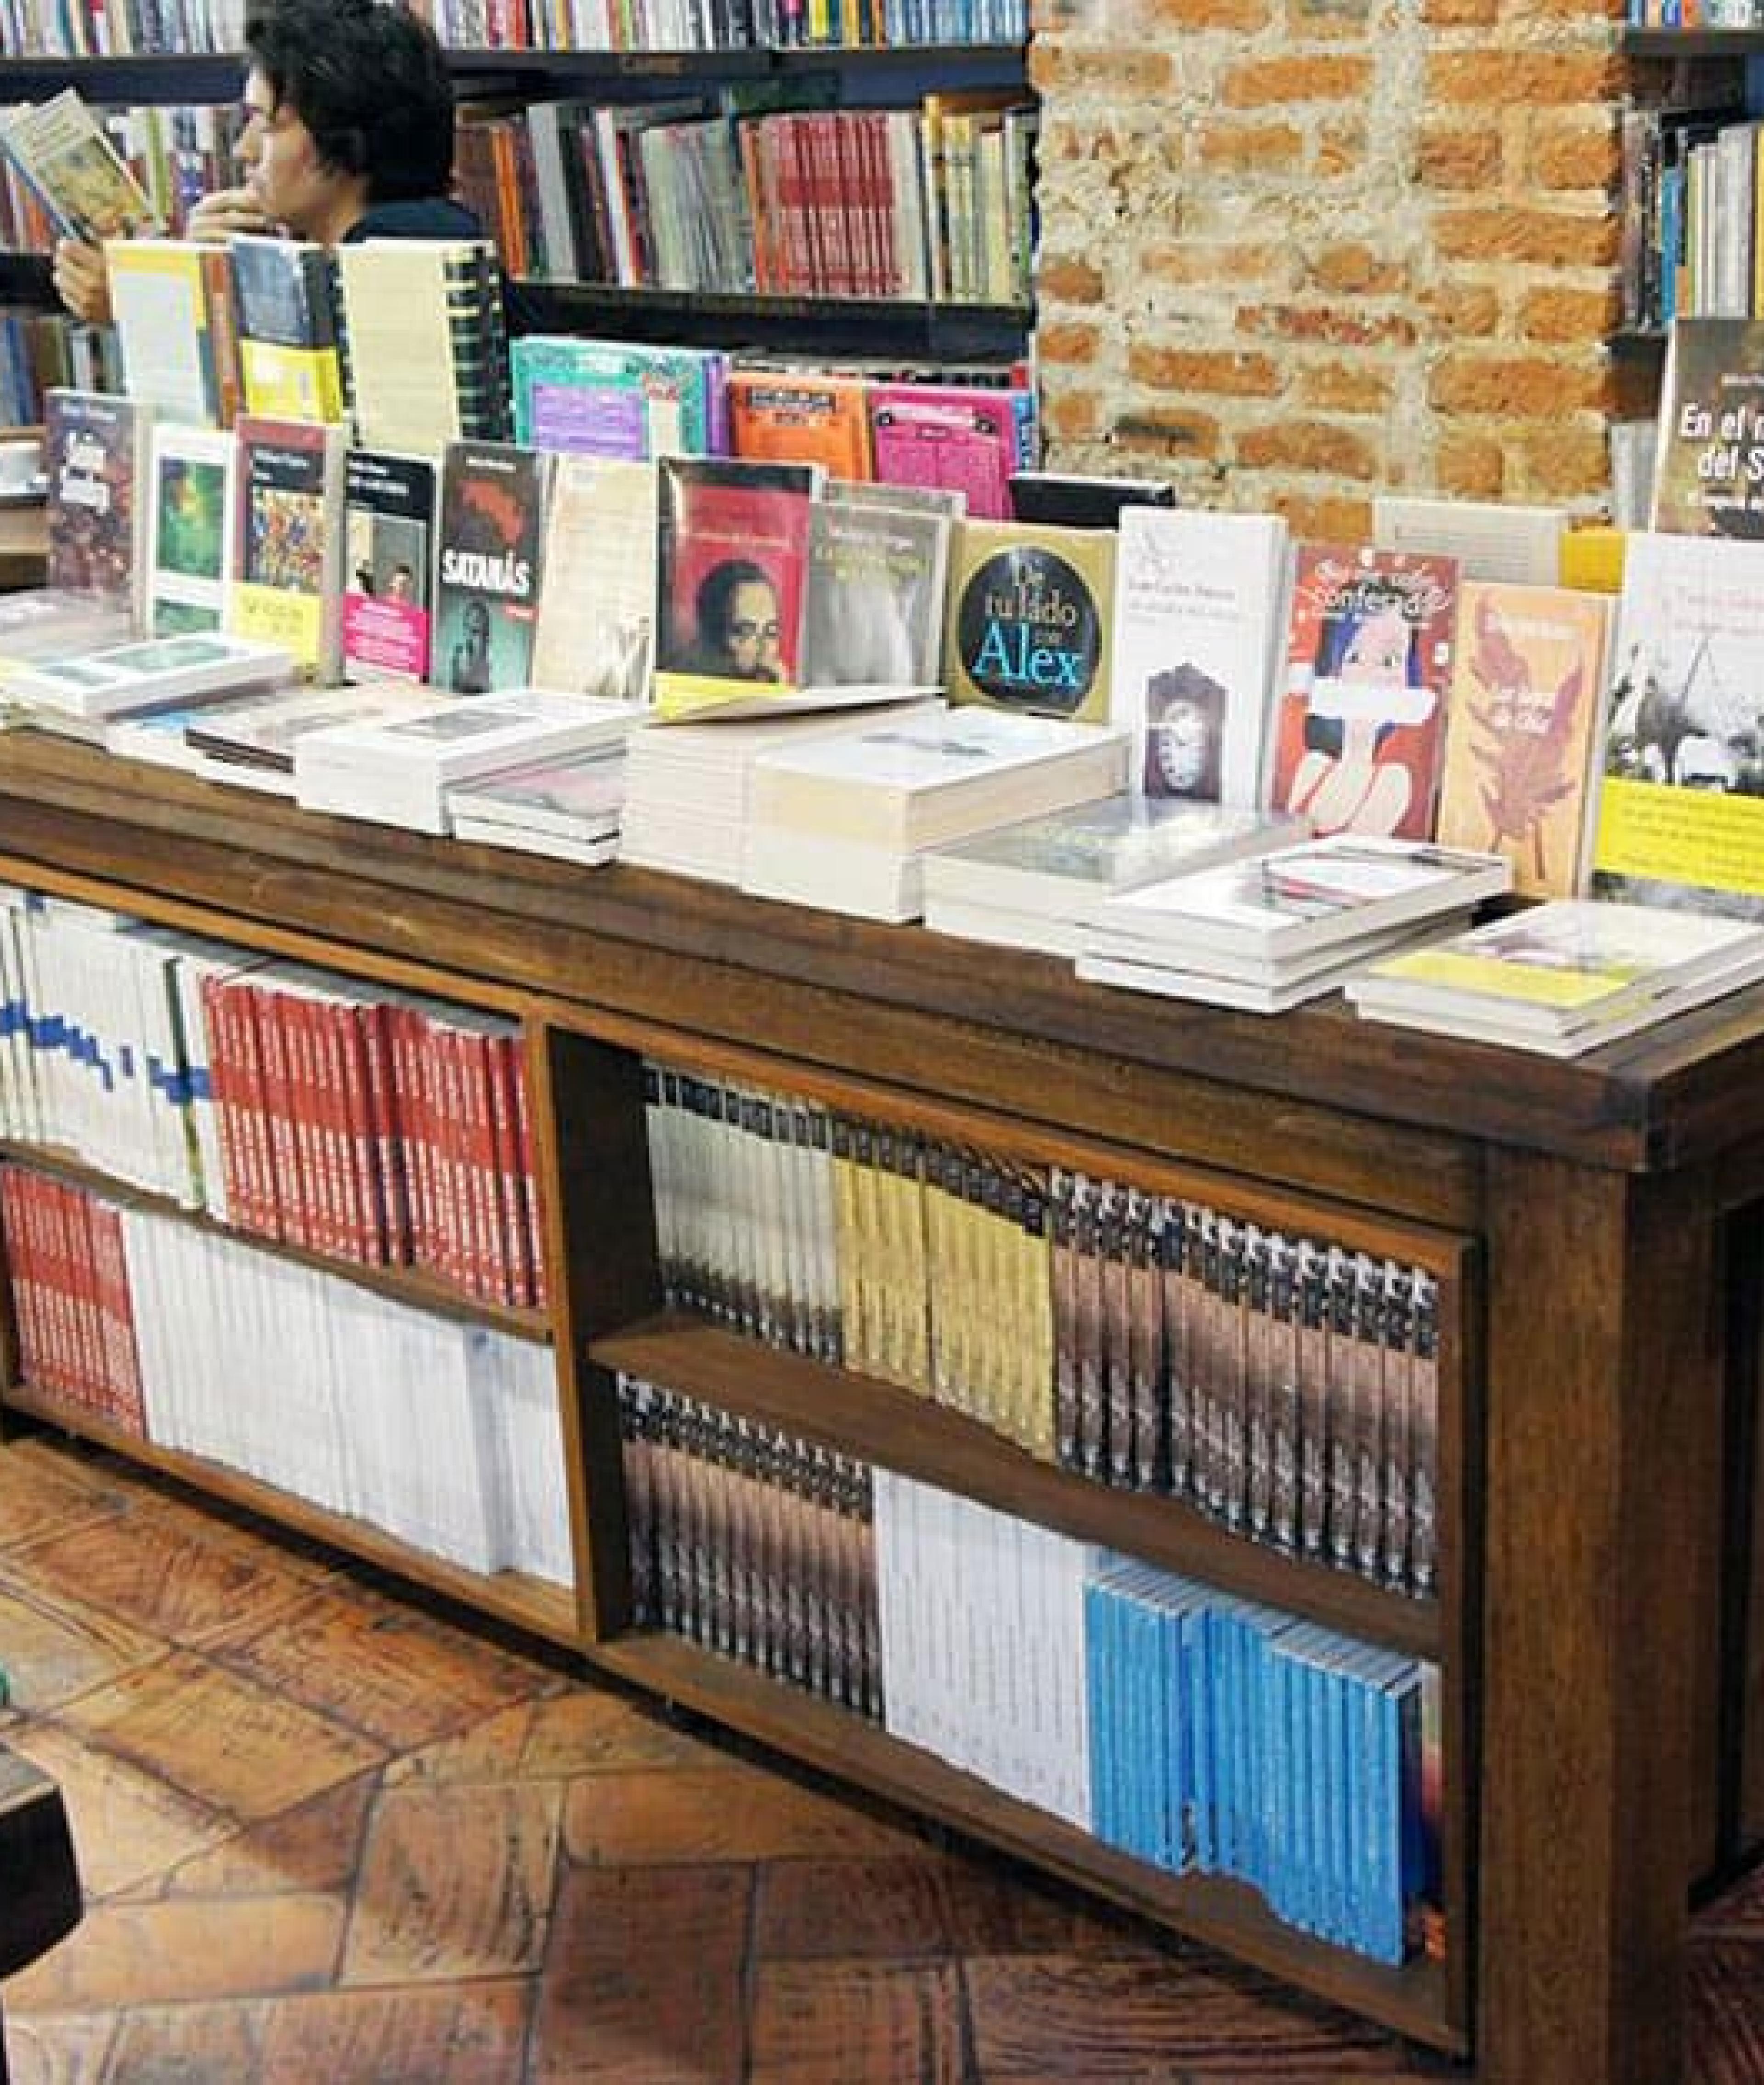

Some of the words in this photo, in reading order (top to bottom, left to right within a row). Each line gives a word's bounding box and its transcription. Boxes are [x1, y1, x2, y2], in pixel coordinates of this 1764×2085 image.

[1681, 402, 1712, 437] En
[1722, 405, 1746, 440] el
[1698, 445, 1739, 480] del
[442, 548, 530, 596] SATANÁS
[971, 621, 1083, 688] Alex
